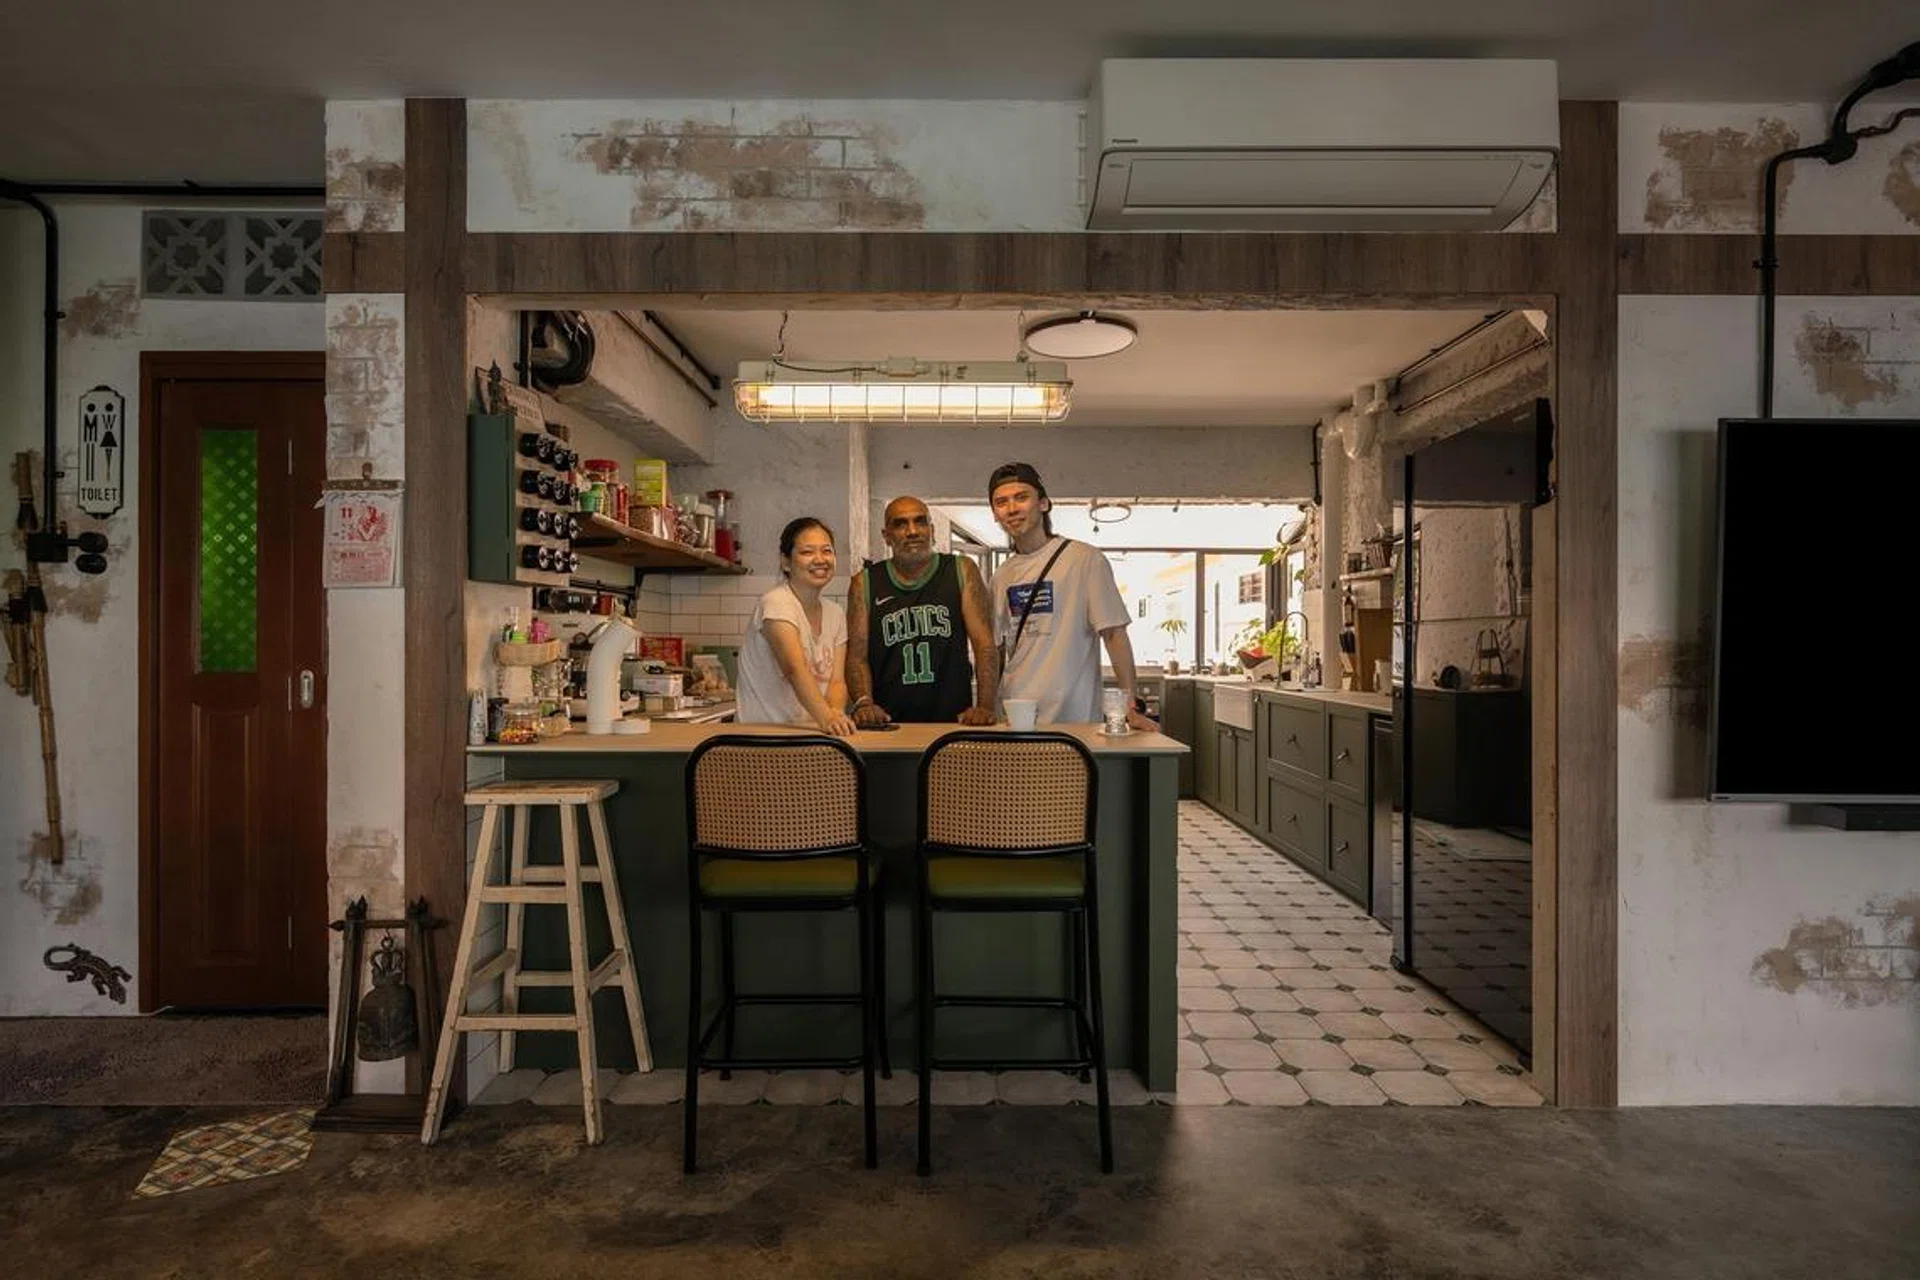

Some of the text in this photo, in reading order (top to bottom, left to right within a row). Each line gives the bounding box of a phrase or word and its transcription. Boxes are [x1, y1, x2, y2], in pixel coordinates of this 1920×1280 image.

[81, 487, 118, 501] TOILET
[881, 604, 952, 647] CELTICS
[902, 641, 935, 685] 11
